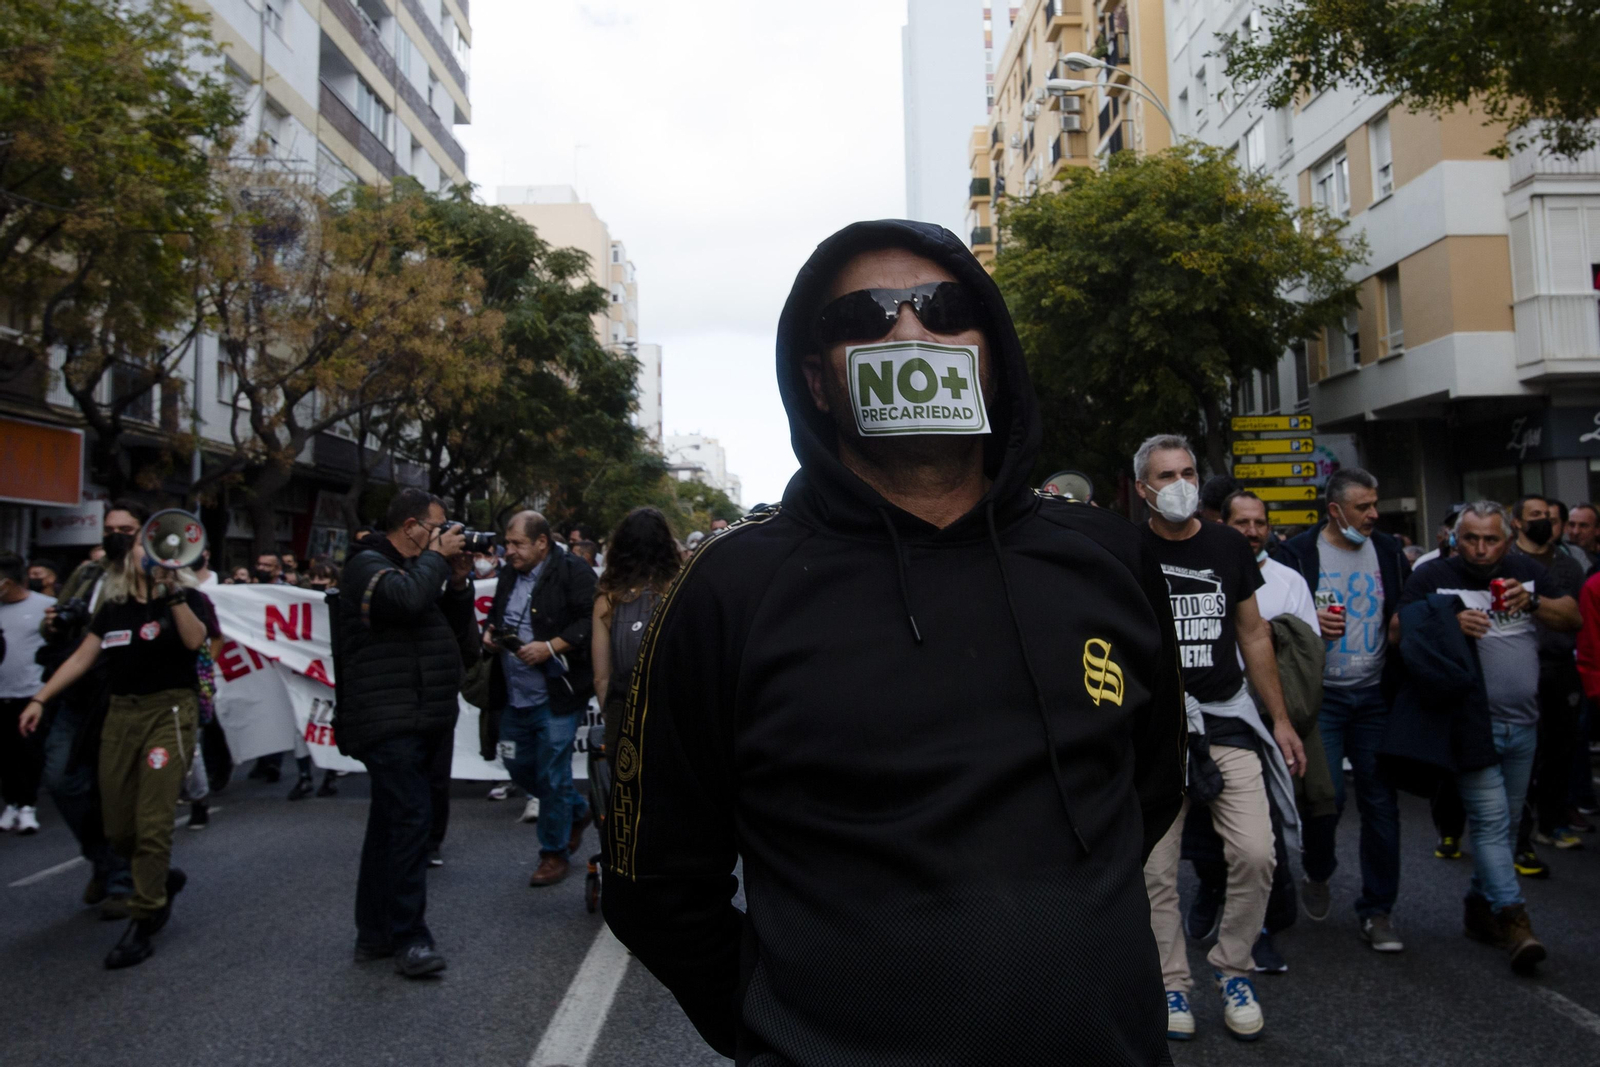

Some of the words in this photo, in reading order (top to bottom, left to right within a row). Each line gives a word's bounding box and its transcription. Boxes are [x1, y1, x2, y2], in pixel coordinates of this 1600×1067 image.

[858, 357, 969, 407] NO+
[861, 405, 974, 422] PRECARIEDAD
[266, 603, 312, 640] NI
